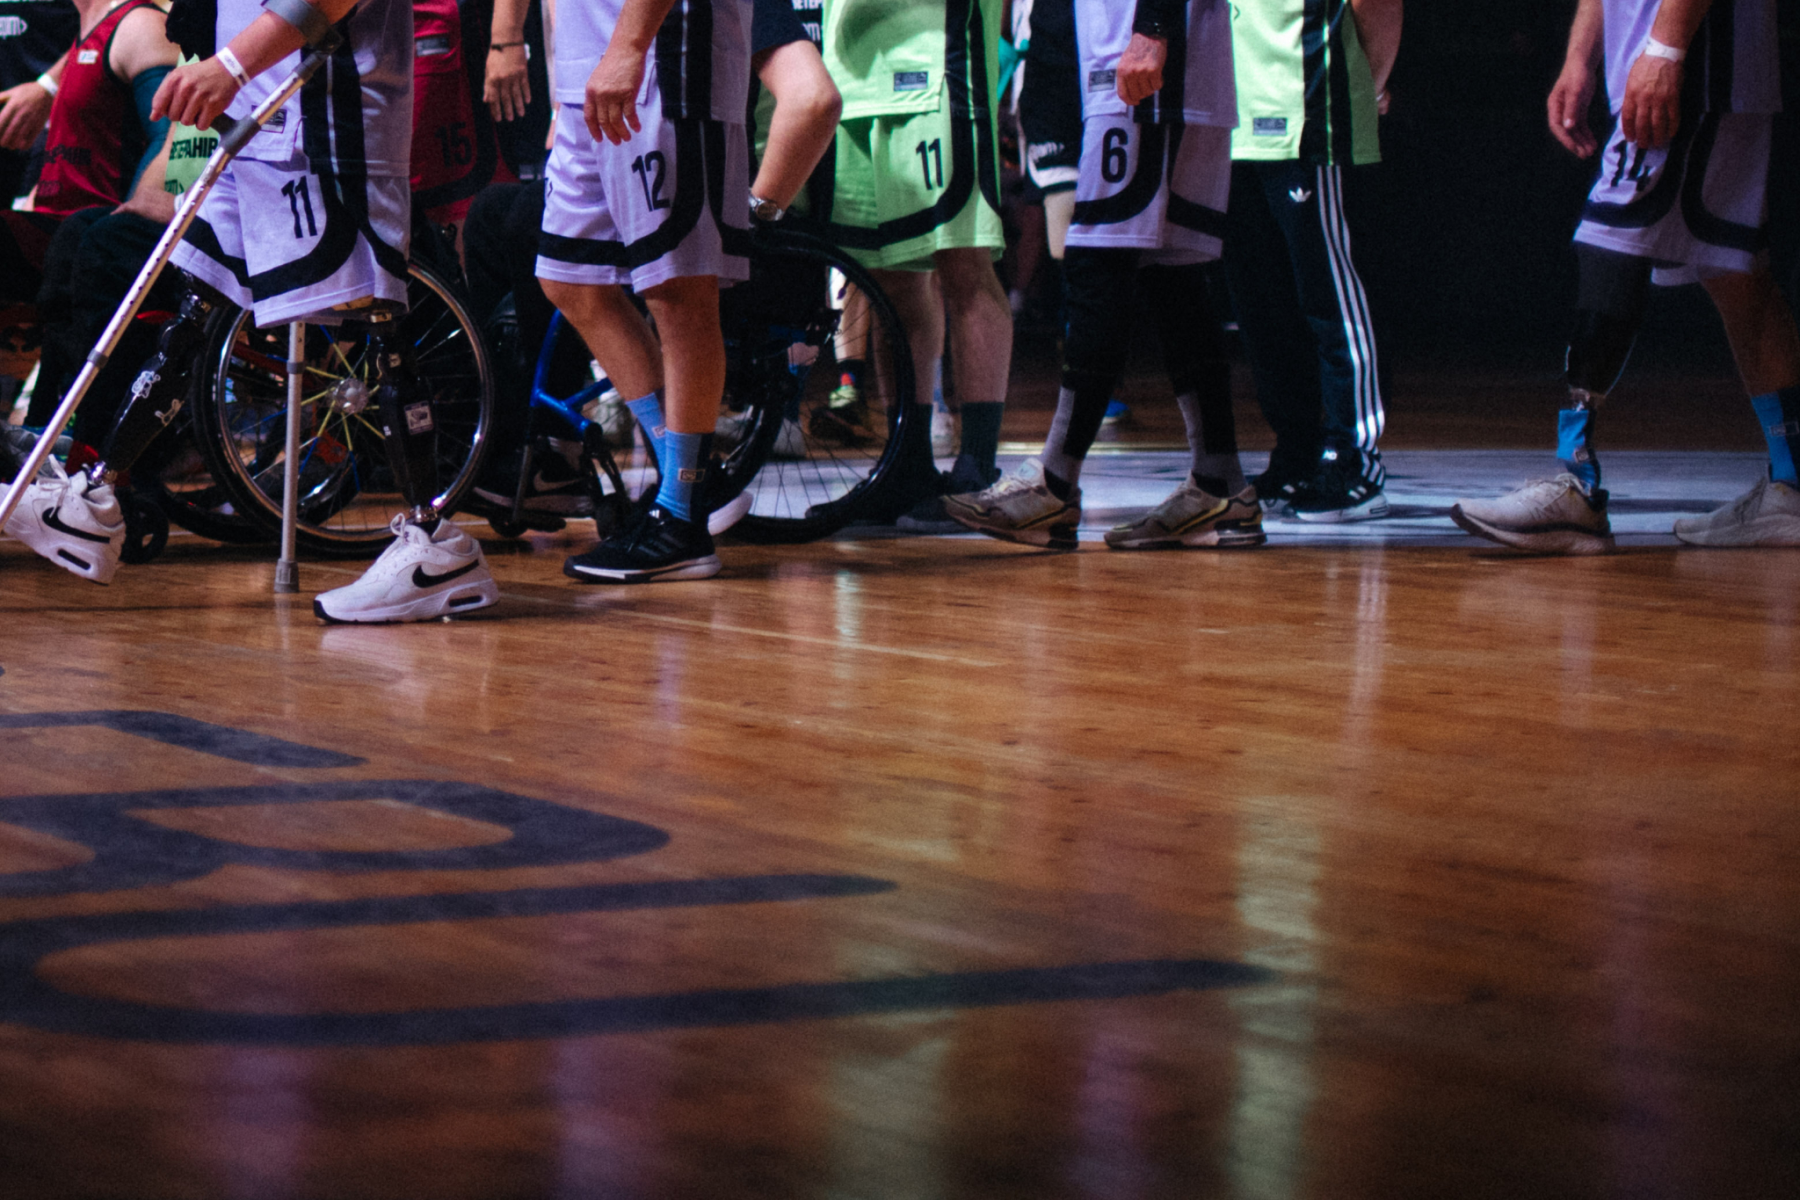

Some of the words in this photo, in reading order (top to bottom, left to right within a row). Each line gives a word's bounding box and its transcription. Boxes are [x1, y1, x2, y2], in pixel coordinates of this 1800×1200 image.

[433, 121, 473, 169] 15
[915, 136, 946, 191] 11
[1100, 127, 1128, 184] 6
[281, 175, 318, 239] 11
[631, 150, 671, 212] 12
